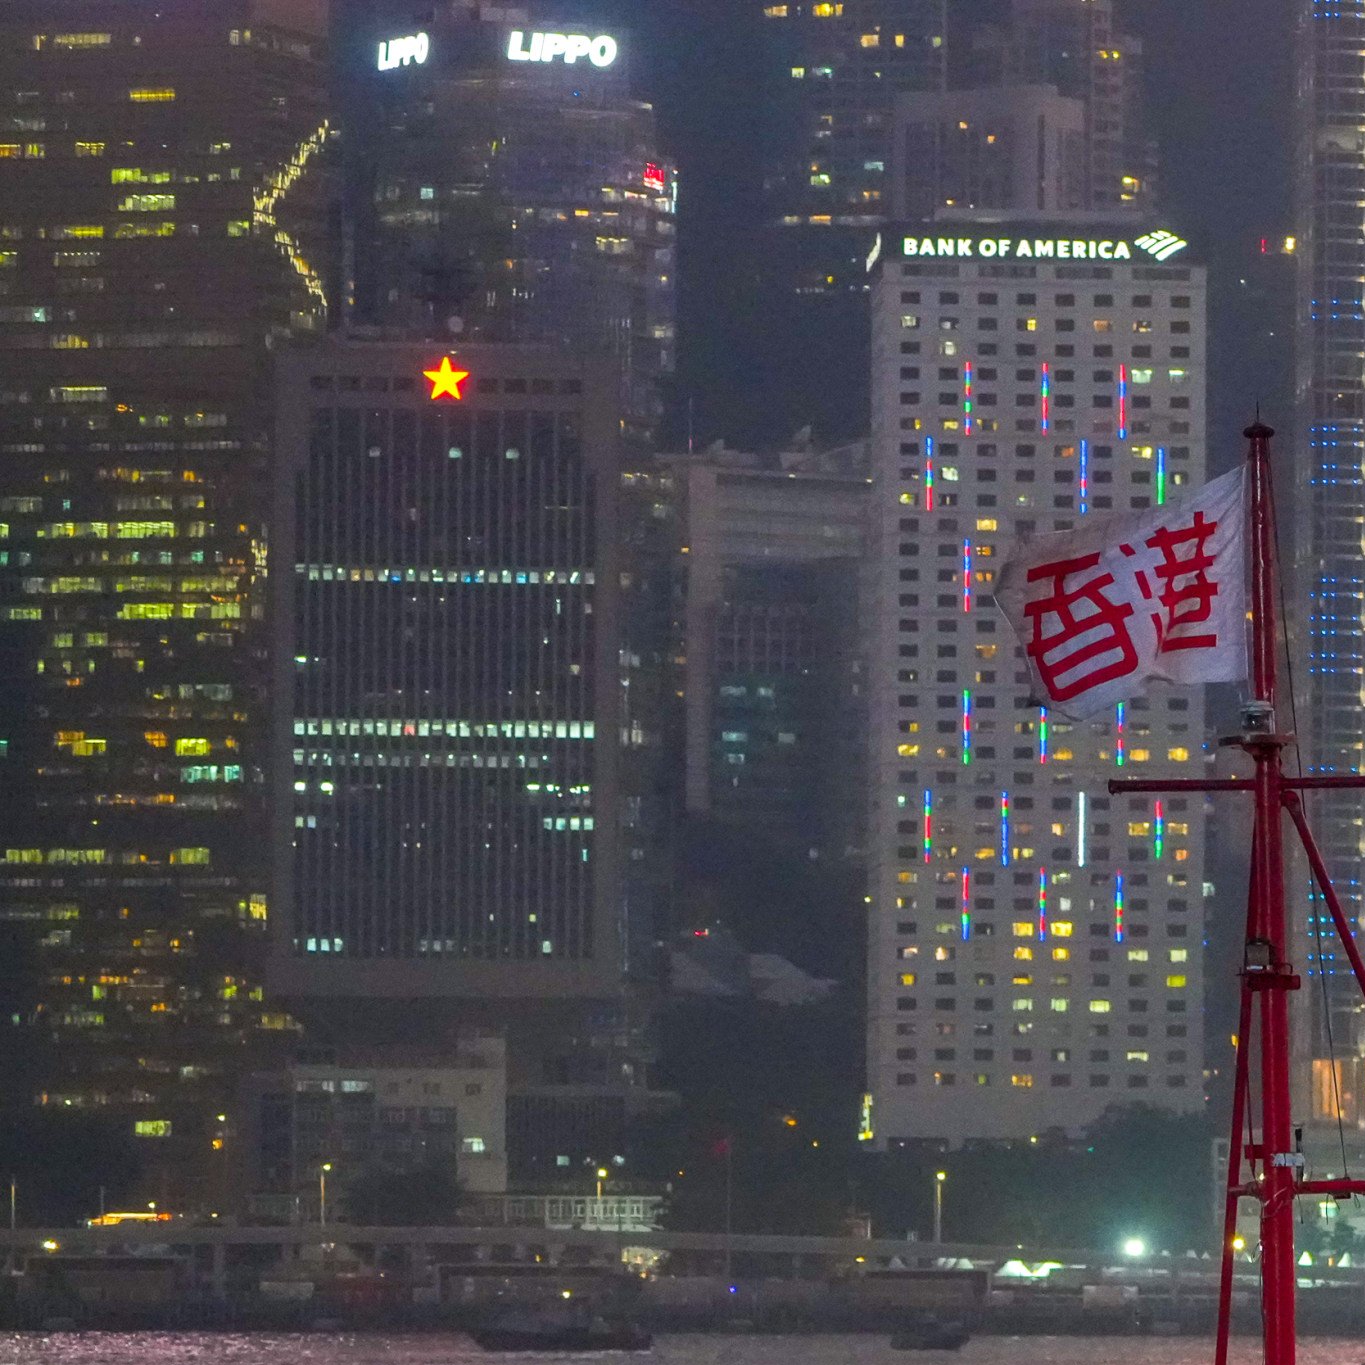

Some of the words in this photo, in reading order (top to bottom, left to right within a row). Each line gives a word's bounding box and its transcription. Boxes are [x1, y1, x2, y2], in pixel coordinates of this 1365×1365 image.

[377, 32, 429, 71] LIPPO
[508, 30, 618, 67] LIPPO
[903, 238, 973, 257] BANK
[978, 239, 1011, 258] OF
[1015, 240, 1131, 260] AMERICA
[1023, 511, 1218, 702] 香港
